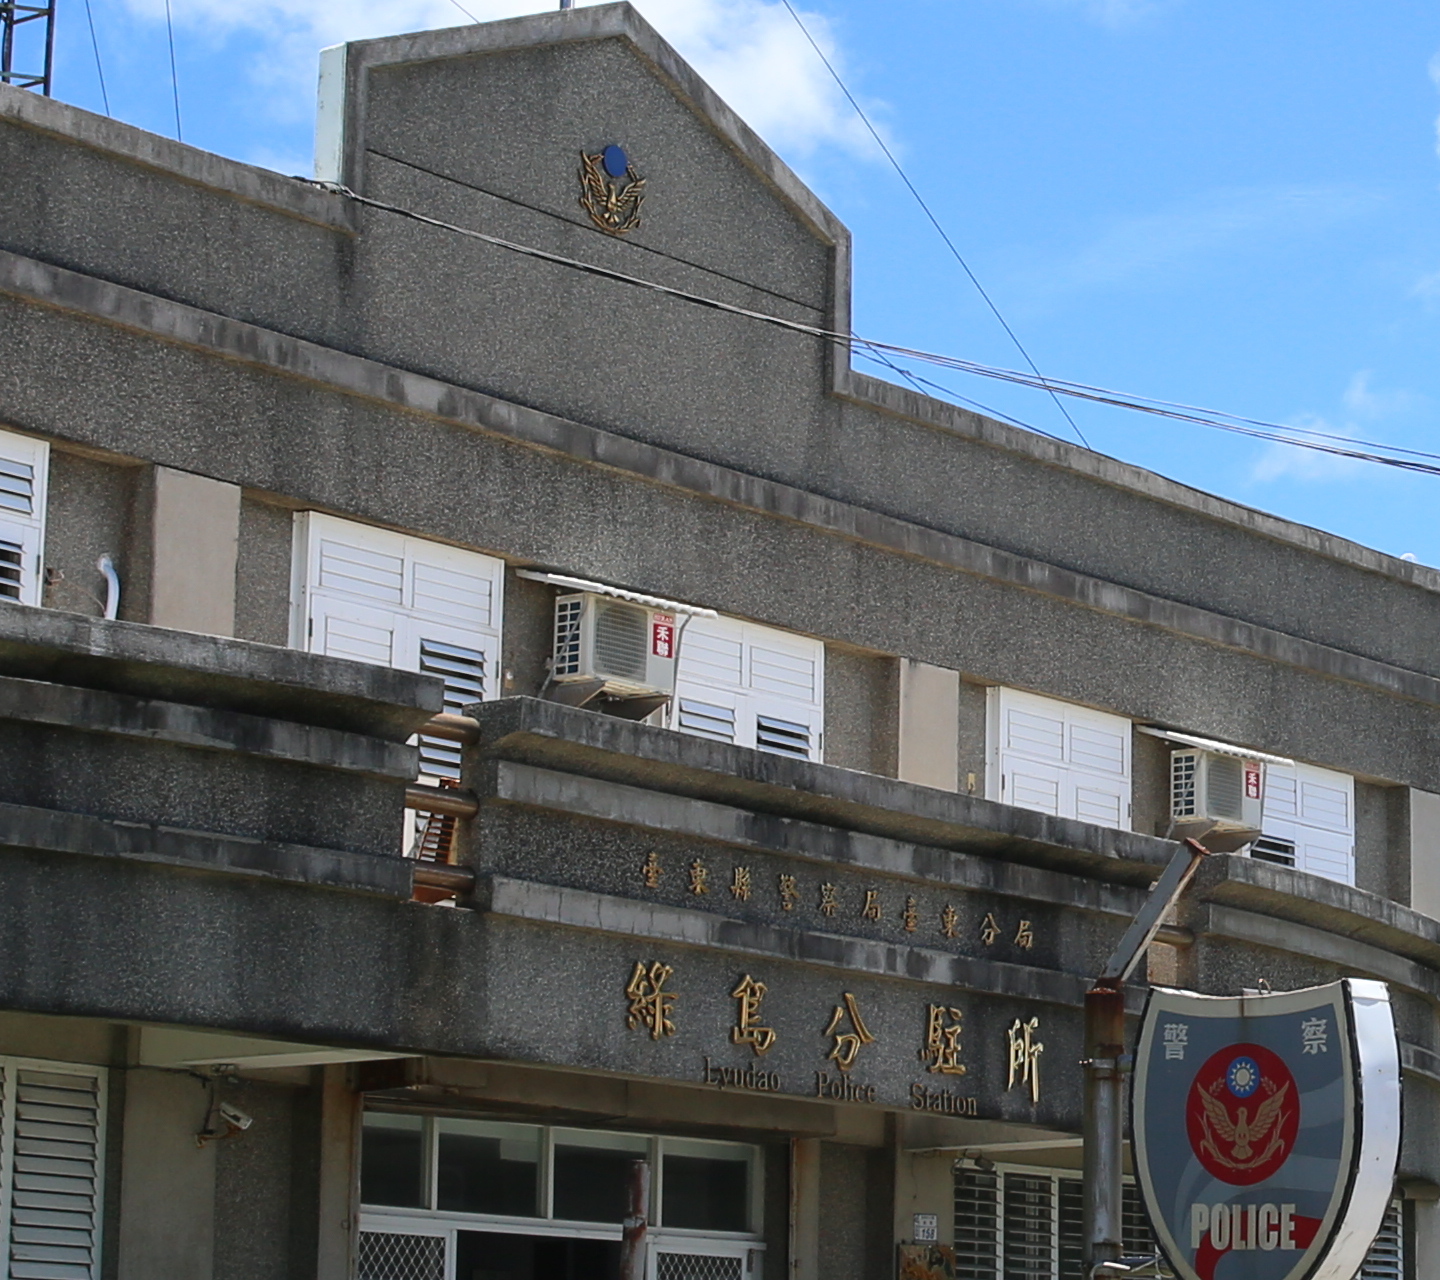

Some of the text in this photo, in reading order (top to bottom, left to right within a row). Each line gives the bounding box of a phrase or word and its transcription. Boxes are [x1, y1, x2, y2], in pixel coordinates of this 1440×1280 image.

[625, 961, 1044, 1104] 綠島分駐所
[704, 1056, 978, 1116] Lyudao Police Station
[1191, 1203, 1296, 1251] POLICE
